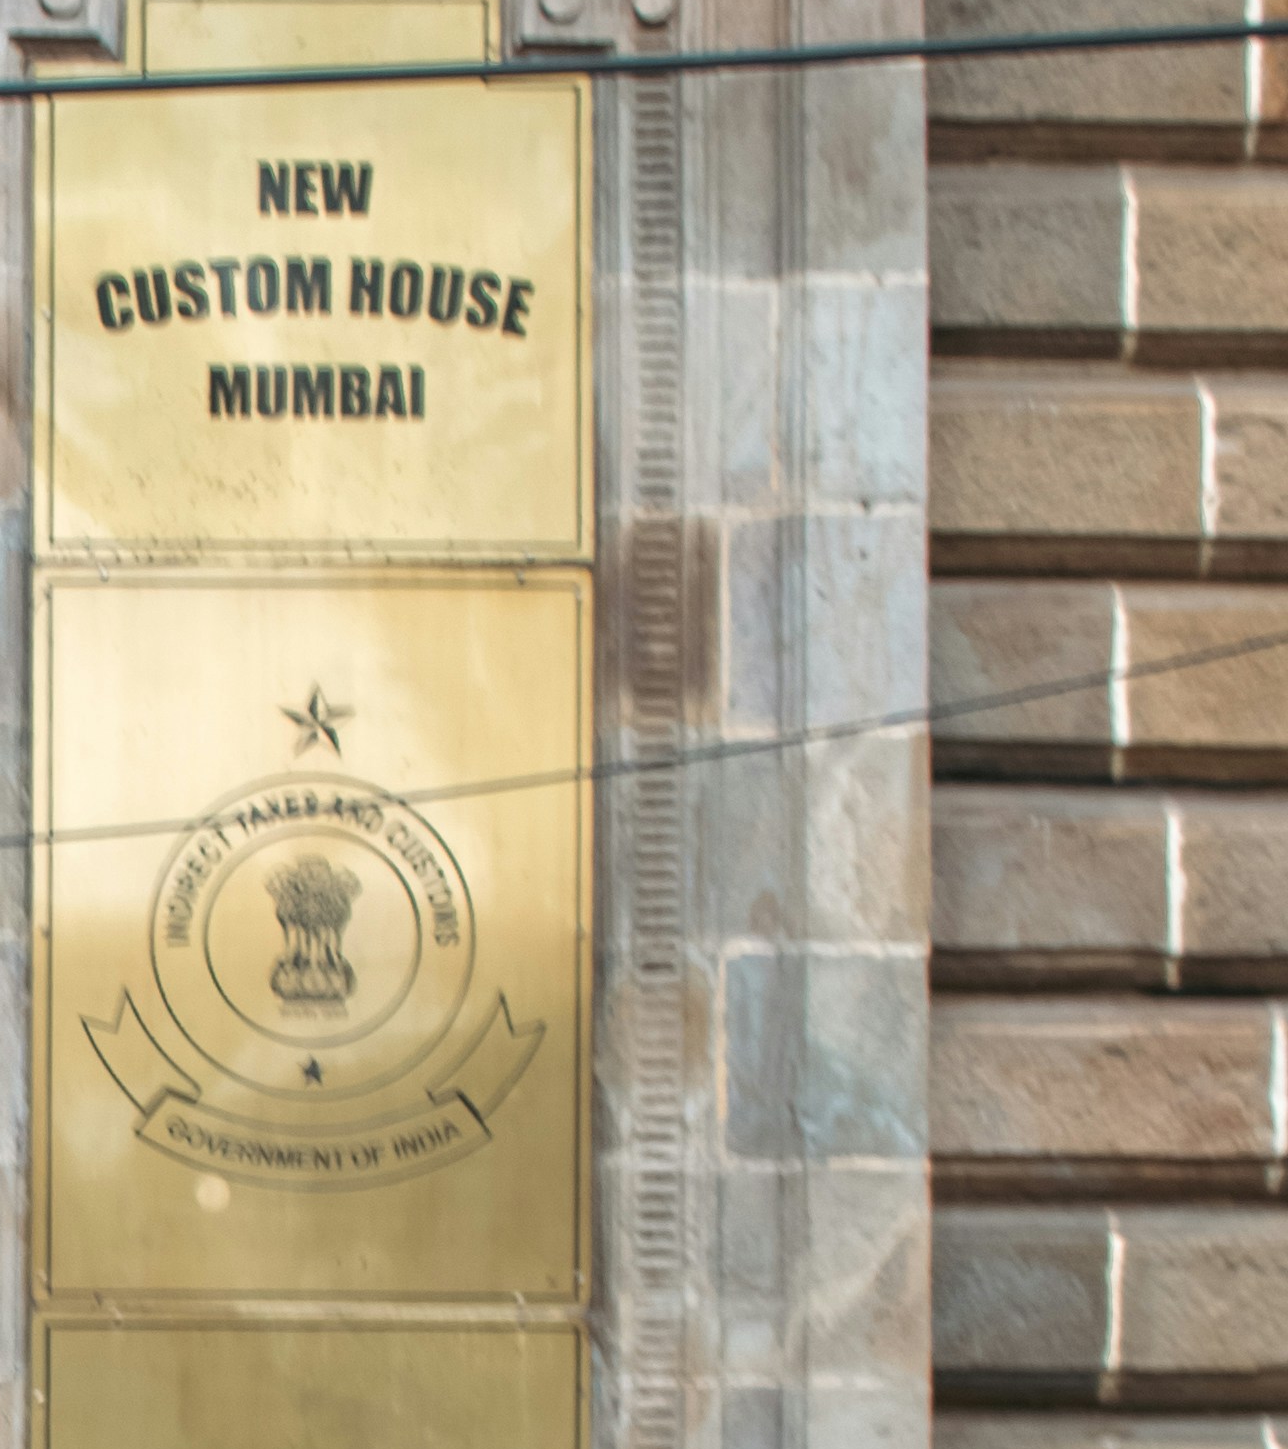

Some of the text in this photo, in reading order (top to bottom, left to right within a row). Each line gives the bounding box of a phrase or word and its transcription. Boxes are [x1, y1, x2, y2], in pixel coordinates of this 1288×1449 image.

[258, 160, 373, 215] NEW
[94, 257, 535, 336] CUSTOM HOUSE
[208, 364, 426, 419] MUMBAI
[166, 1113, 462, 1171] GOVERNMENT OF INDIA
